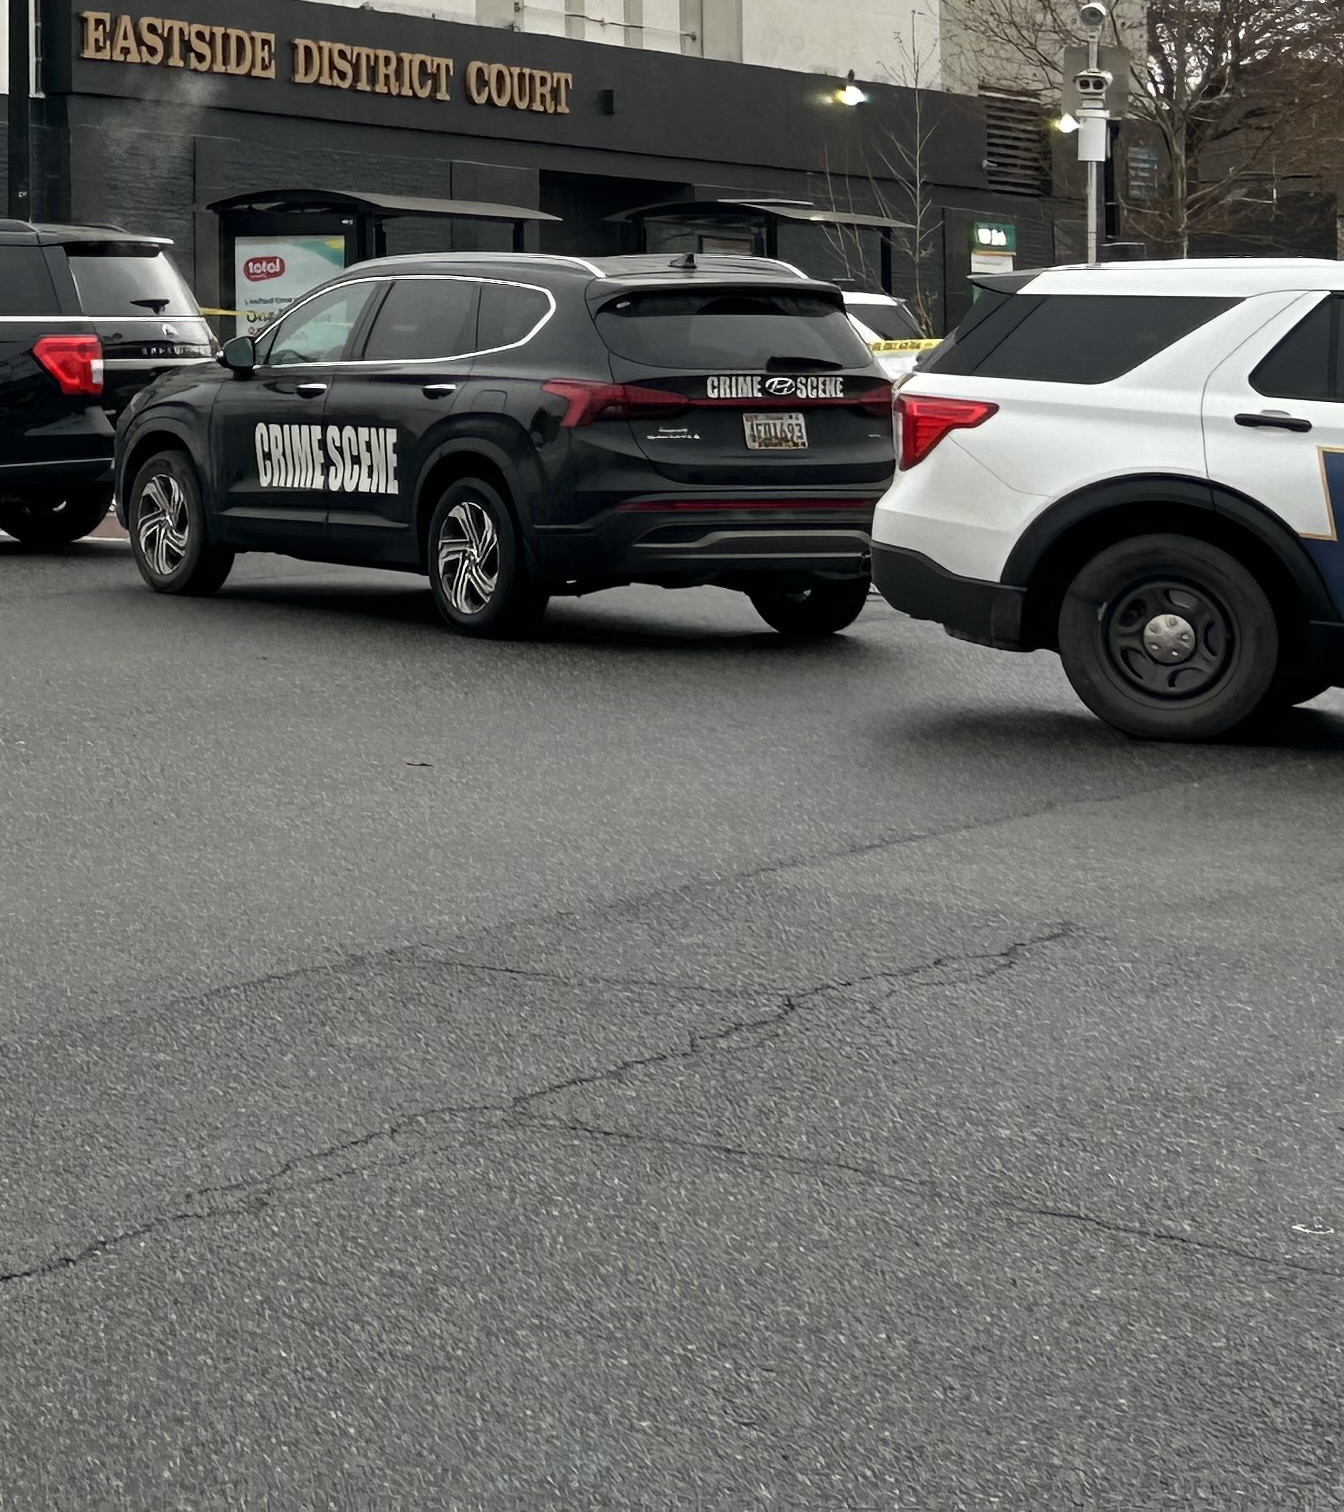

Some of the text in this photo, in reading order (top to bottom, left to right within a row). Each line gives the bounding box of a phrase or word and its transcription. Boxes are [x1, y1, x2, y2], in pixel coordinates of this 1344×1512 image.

[80, 10, 573, 114] EASTSIDE DISTRICT COURT
[706, 376, 844, 399] CRIME SCENE
[255, 422, 399, 495] CRIME SCENE
